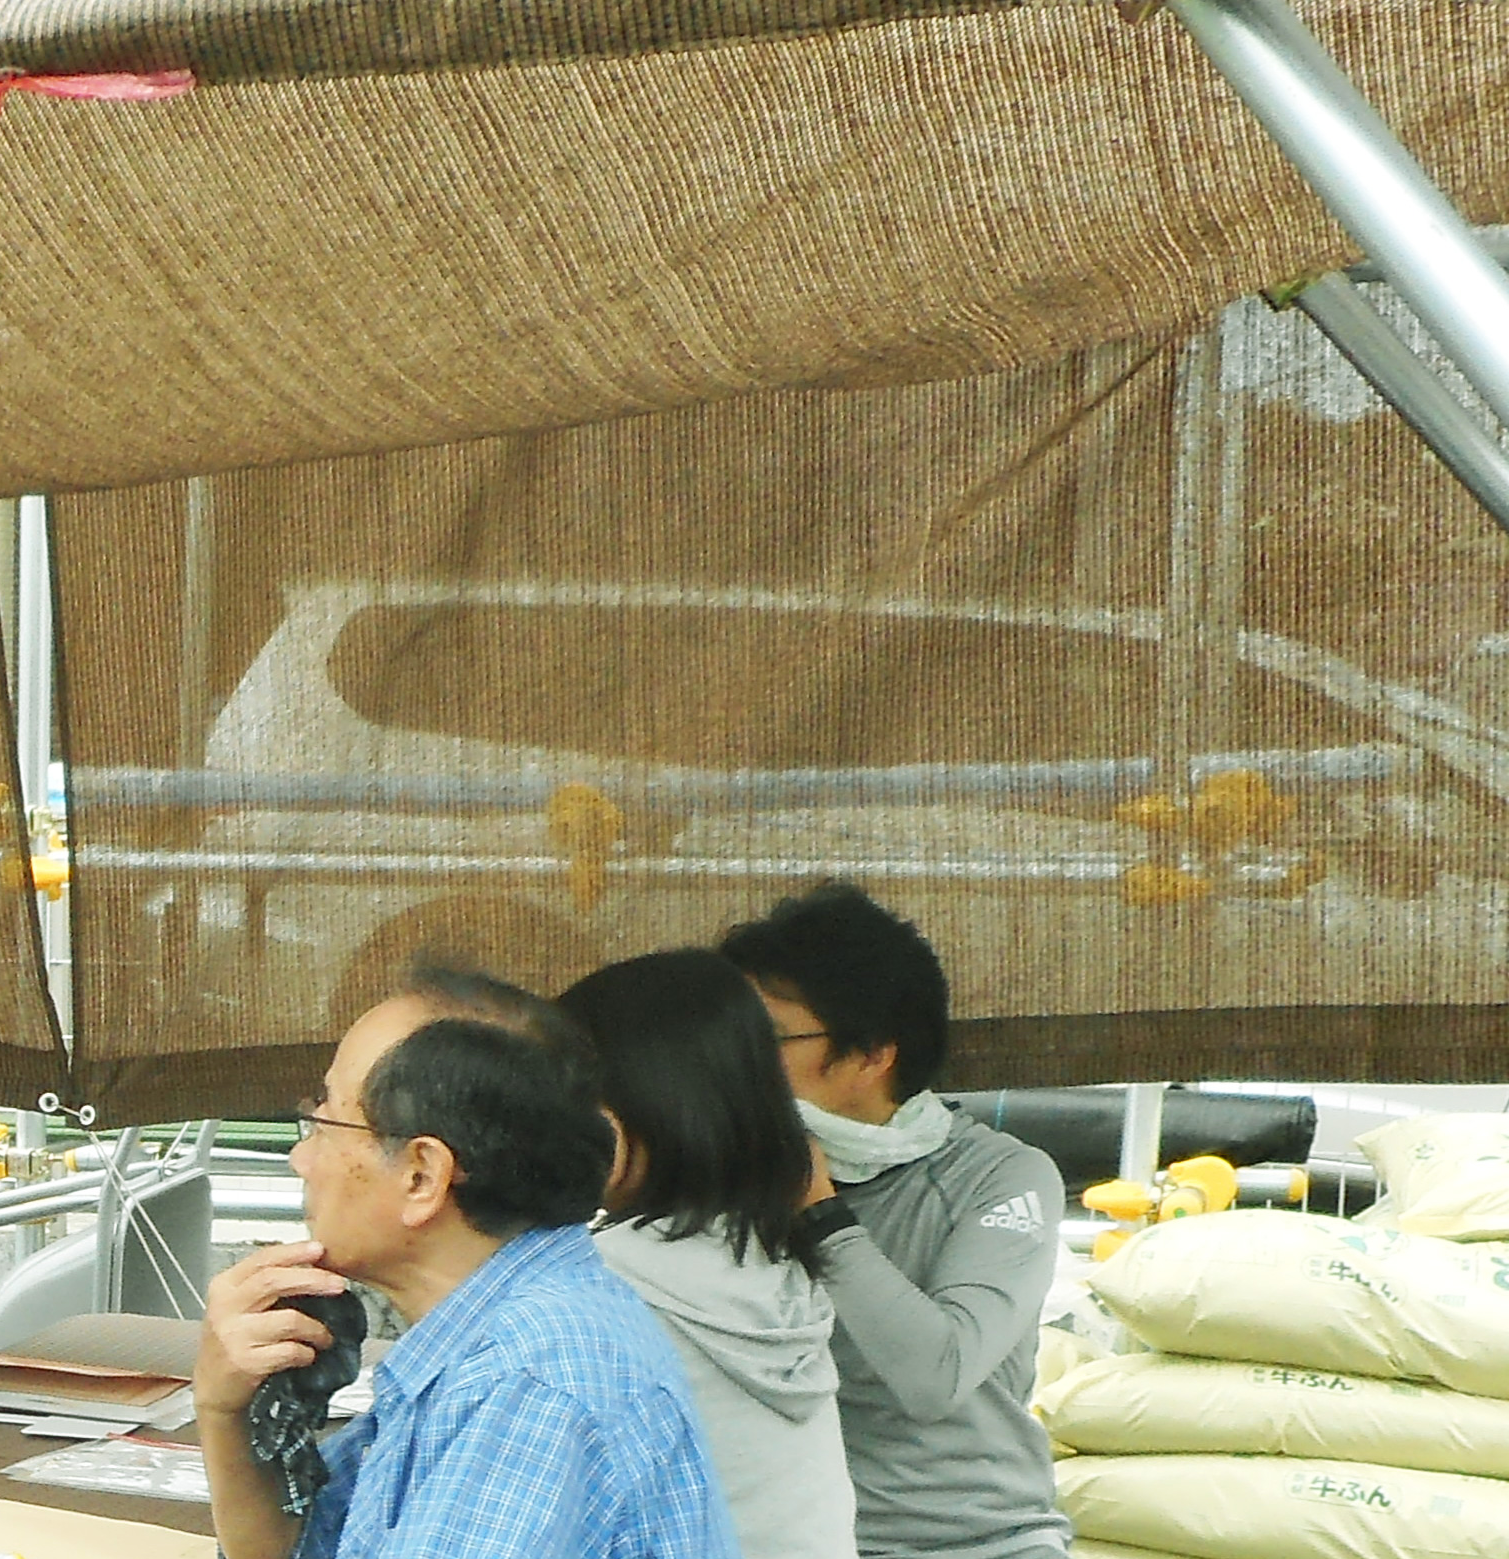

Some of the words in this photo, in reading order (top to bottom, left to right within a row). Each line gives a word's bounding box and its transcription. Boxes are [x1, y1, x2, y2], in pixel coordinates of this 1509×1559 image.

[980, 1214, 1039, 1234] adid
[1271, 1369, 1354, 1391] 牛ふん
[1309, 1475, 1391, 1508] 牛ふん
